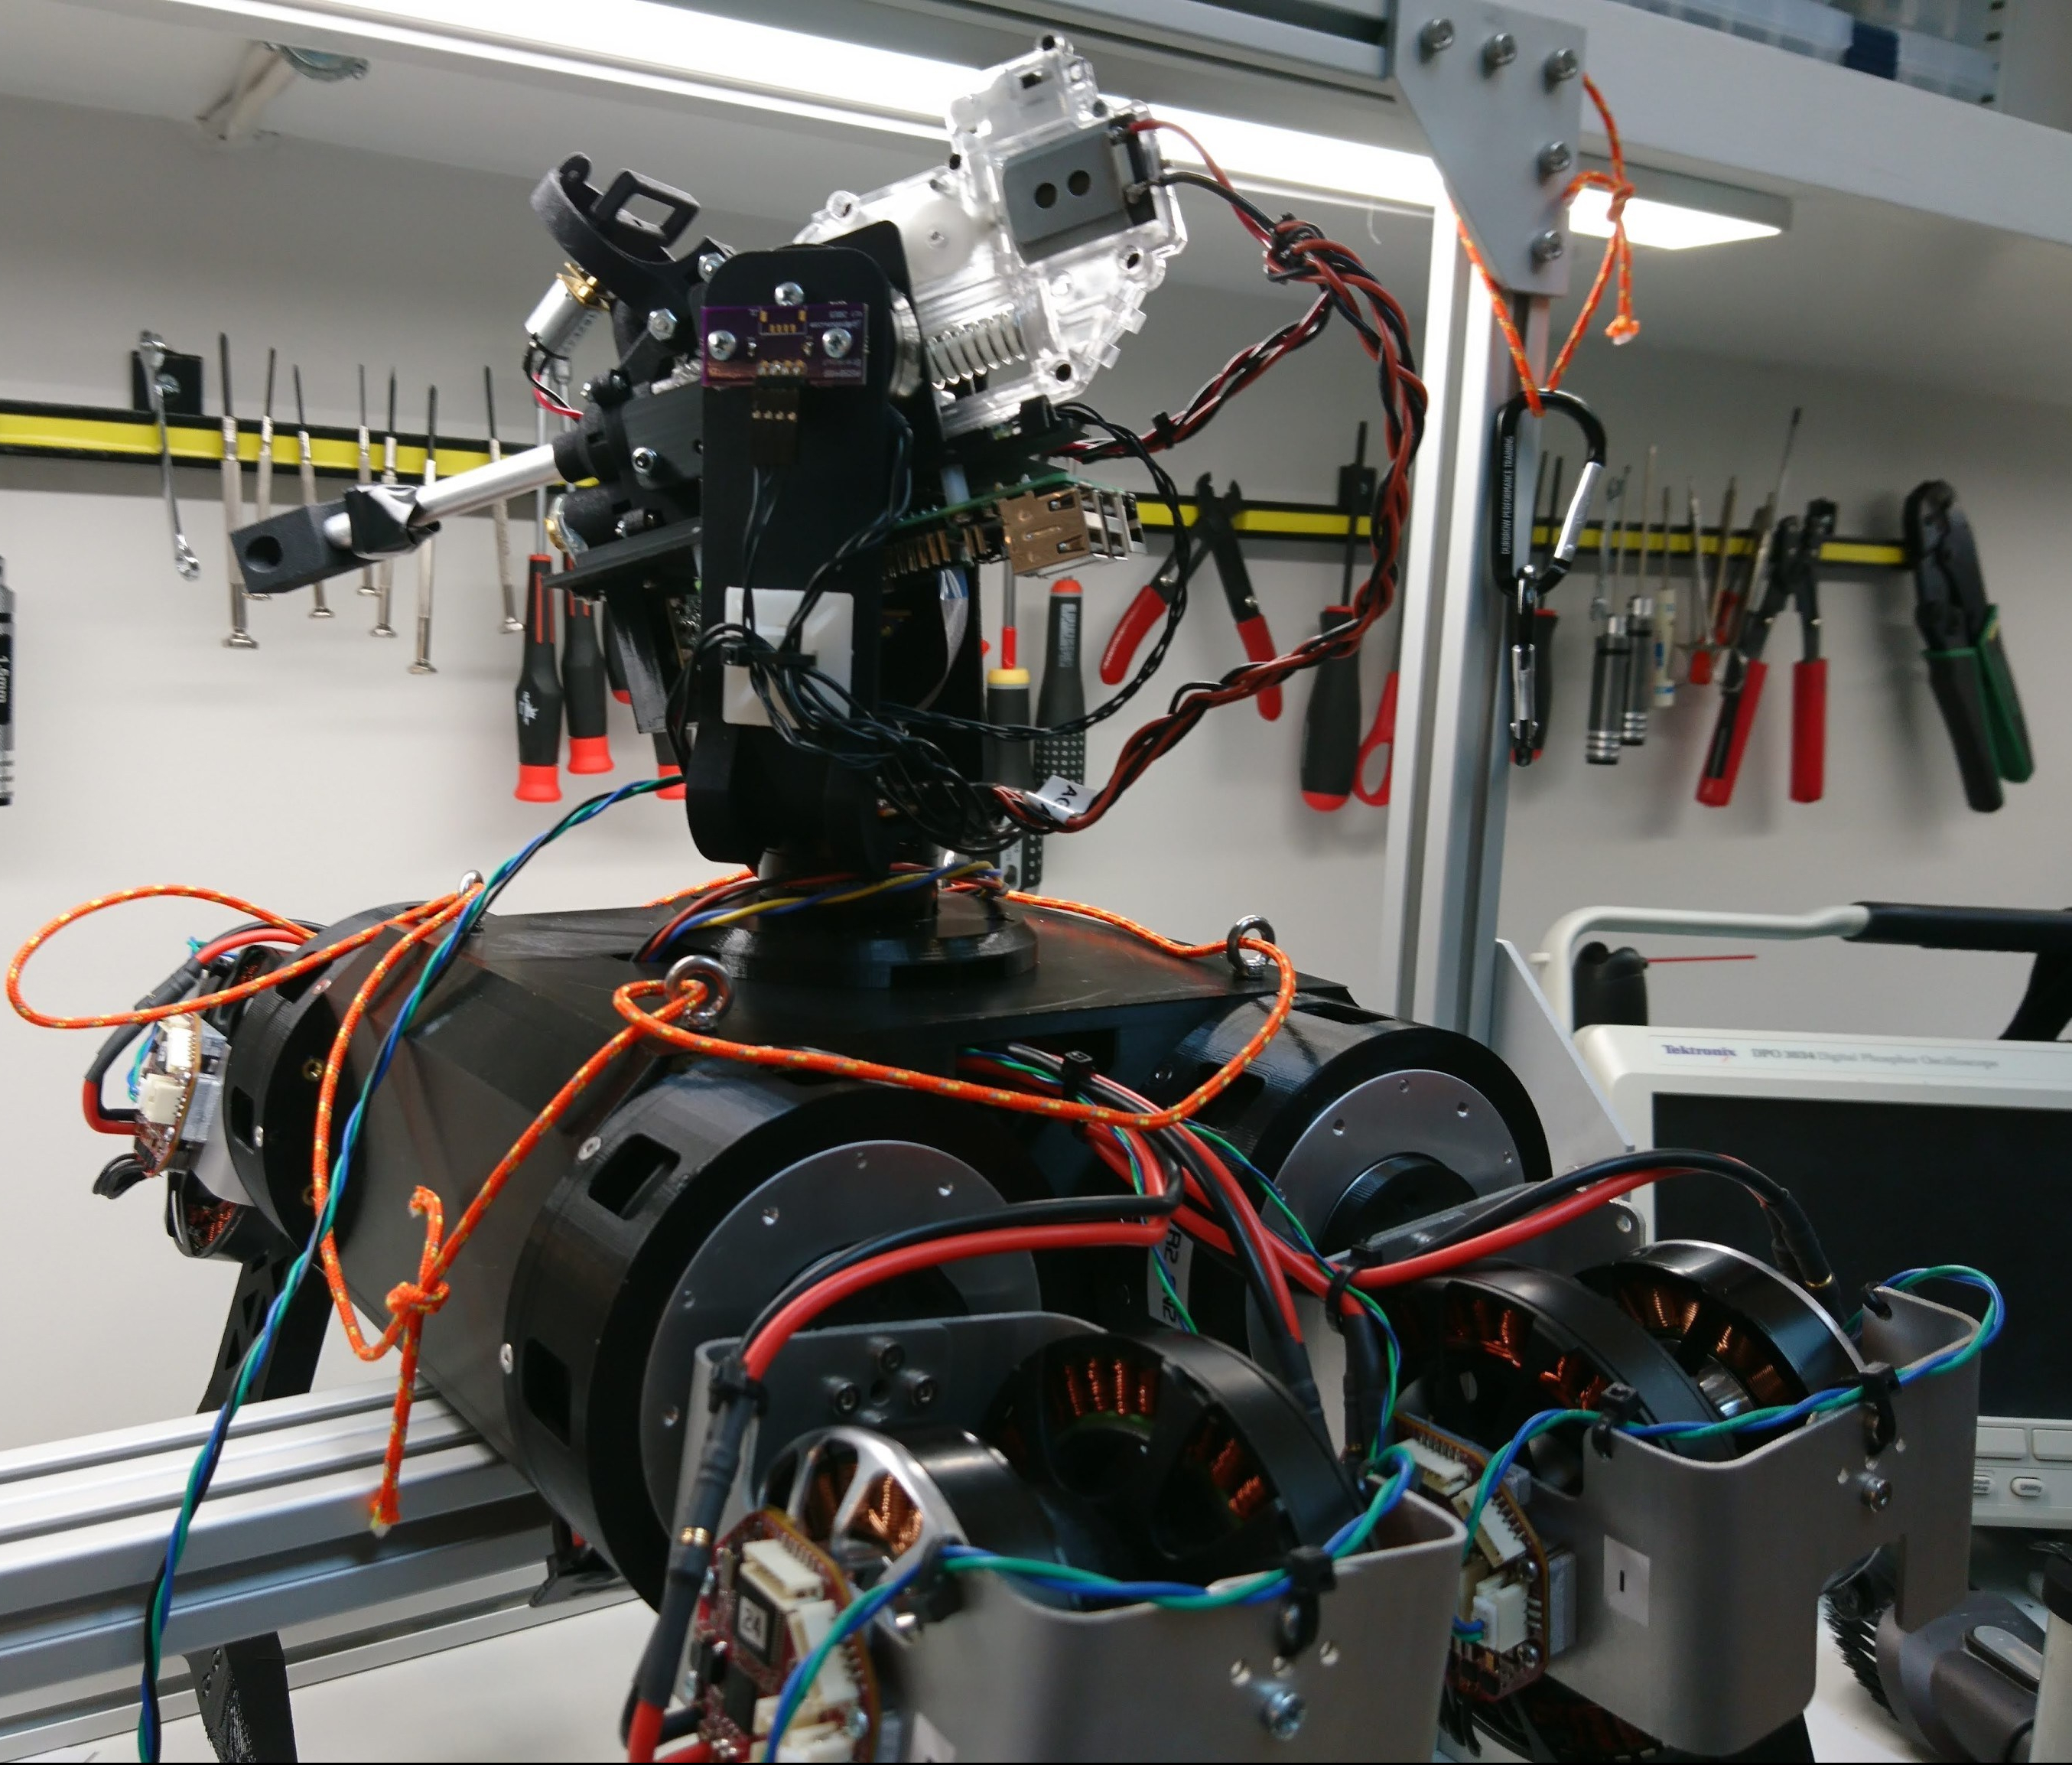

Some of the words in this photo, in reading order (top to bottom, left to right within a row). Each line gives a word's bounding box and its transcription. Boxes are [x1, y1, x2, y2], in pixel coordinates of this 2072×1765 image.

[1502, 435, 1514, 467] TRAINING
[1501, 469, 1514, 518] PERFORMANCE
[1661, 1044, 1737, 1057] Tektronix
